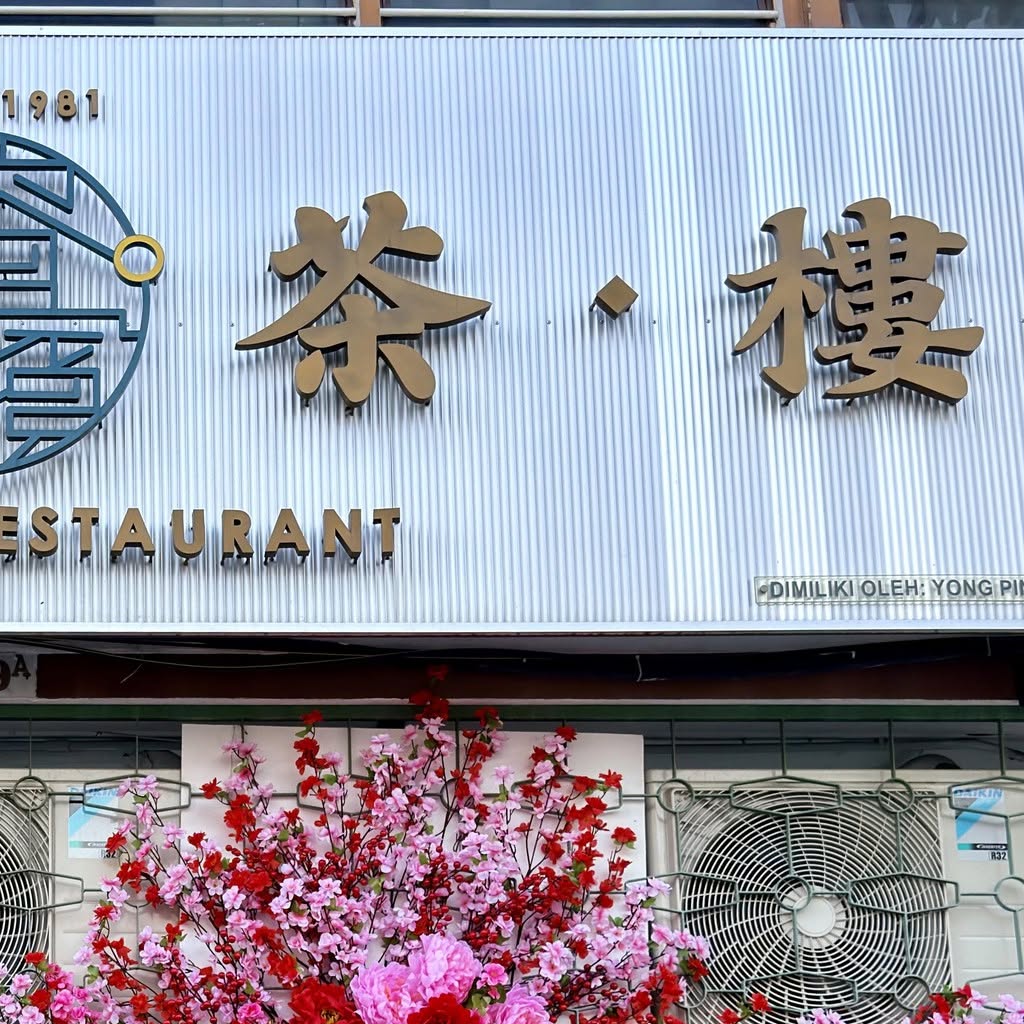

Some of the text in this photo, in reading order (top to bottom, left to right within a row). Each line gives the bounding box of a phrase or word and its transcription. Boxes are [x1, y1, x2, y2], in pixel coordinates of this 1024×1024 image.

[2, 89, 99, 118] 1981
[235, 190, 493, 407] 茶
[725, 197, 984, 405] 樓
[770, 580, 854, 598] DIMILIKI
[861, 579, 925, 597] OLEH:
[932, 578, 993, 597] YONG
[991, 851, 1007, 860] R32
